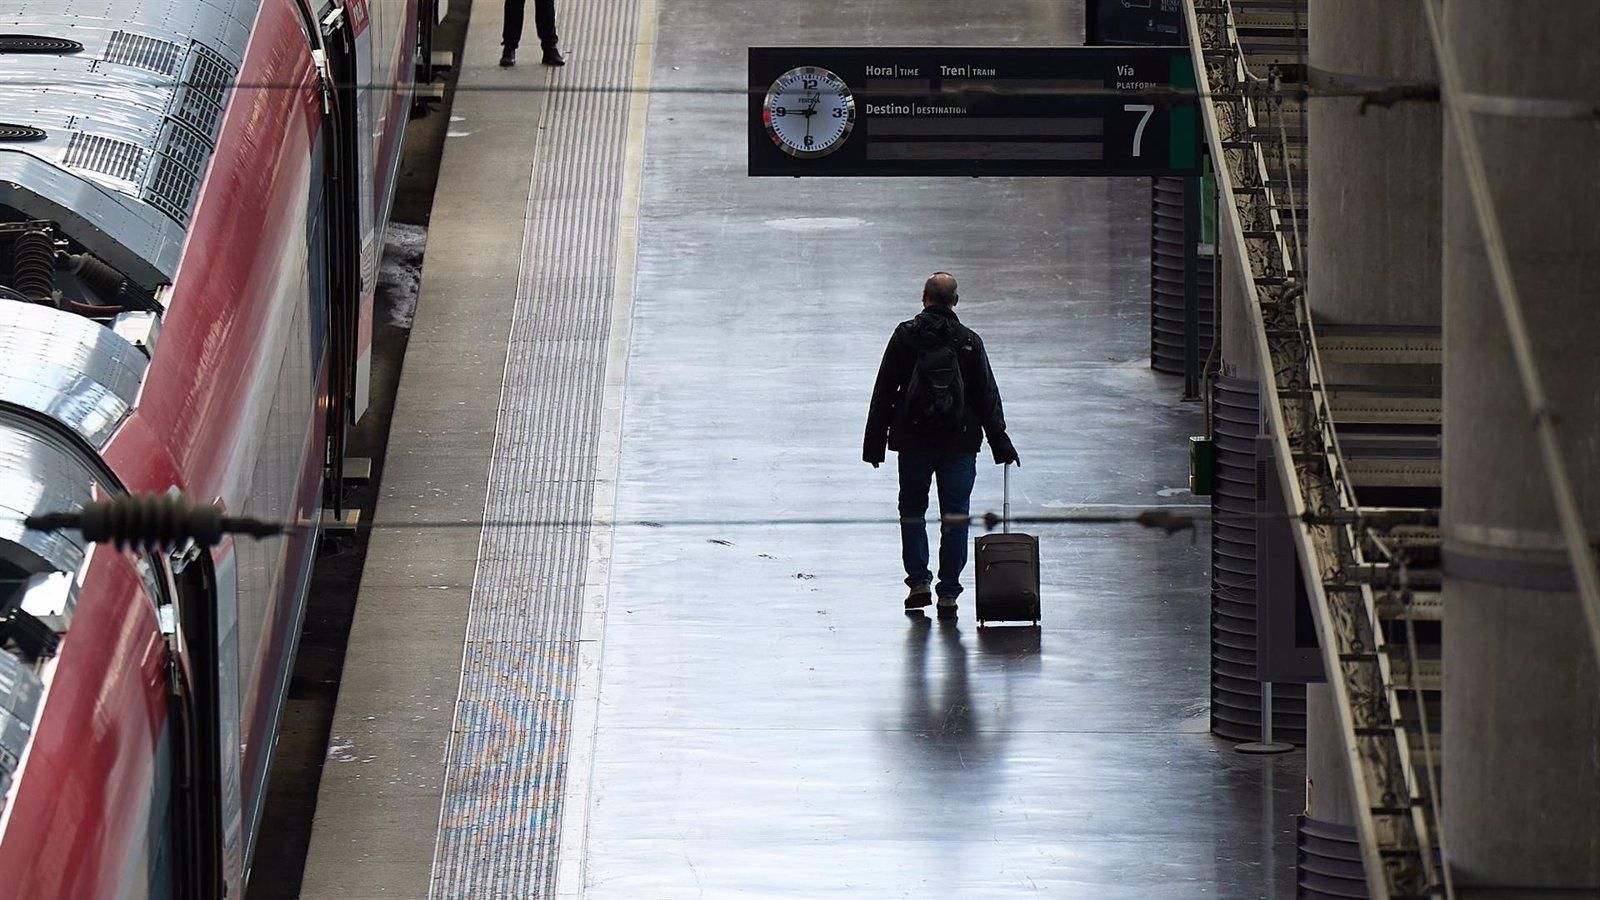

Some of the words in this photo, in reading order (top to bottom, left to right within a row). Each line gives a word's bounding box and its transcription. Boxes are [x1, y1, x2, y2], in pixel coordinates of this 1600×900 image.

[865, 65, 893, 76] Hora
[900, 68, 919, 76] TIME
[940, 65, 965, 76] Tren
[972, 68, 996, 76] TRAIN
[1116, 64, 1135, 76] Vía
[802, 79, 818, 90] 12
[1116, 81, 1157, 90] PLATFORM
[775, 106, 786, 117] 9
[831, 107, 843, 118] 3
[866, 103, 910, 115] Destino
[916, 106, 968, 115] DESTINATION
[1123, 104, 1155, 157] 7
[803, 135, 814, 147] 6
